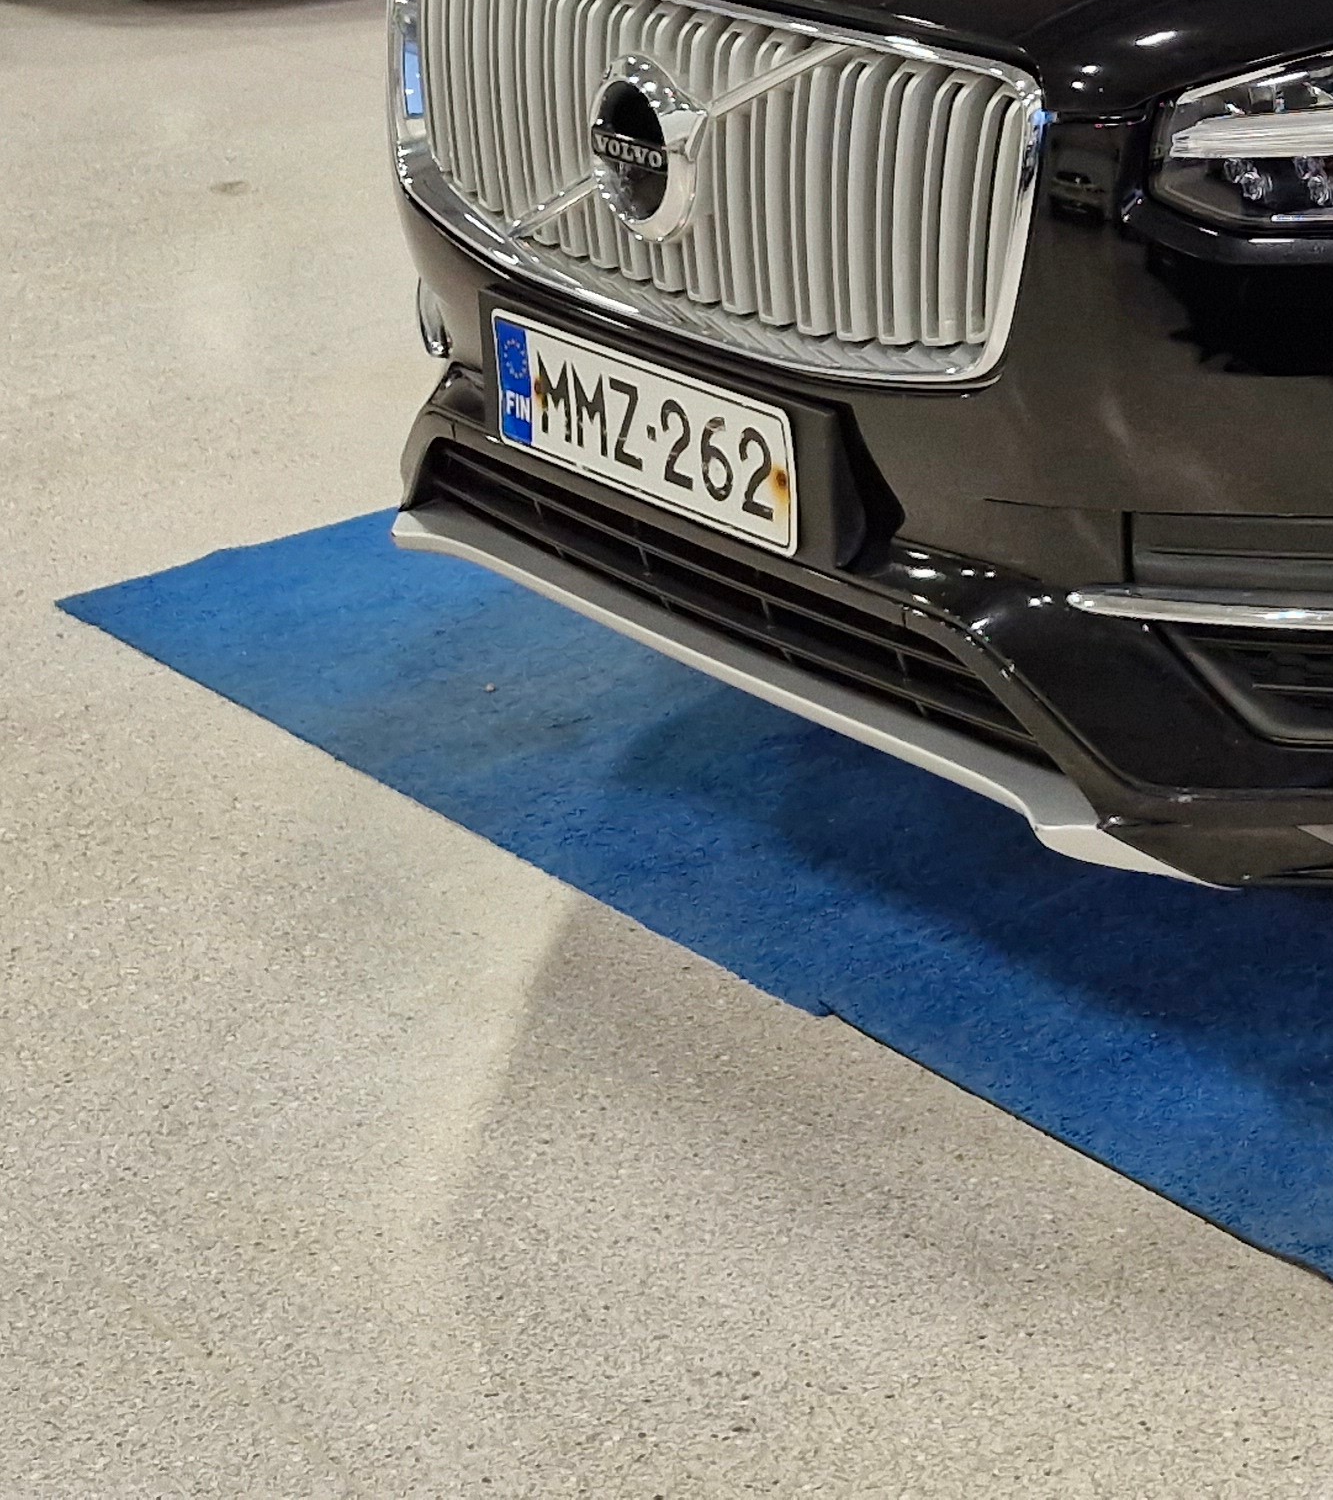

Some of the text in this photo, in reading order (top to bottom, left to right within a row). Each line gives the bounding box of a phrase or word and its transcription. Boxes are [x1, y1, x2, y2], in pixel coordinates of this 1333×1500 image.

[594, 133, 663, 169] VOLVO
[505, 350, 775, 522] FIN MMZ-262
